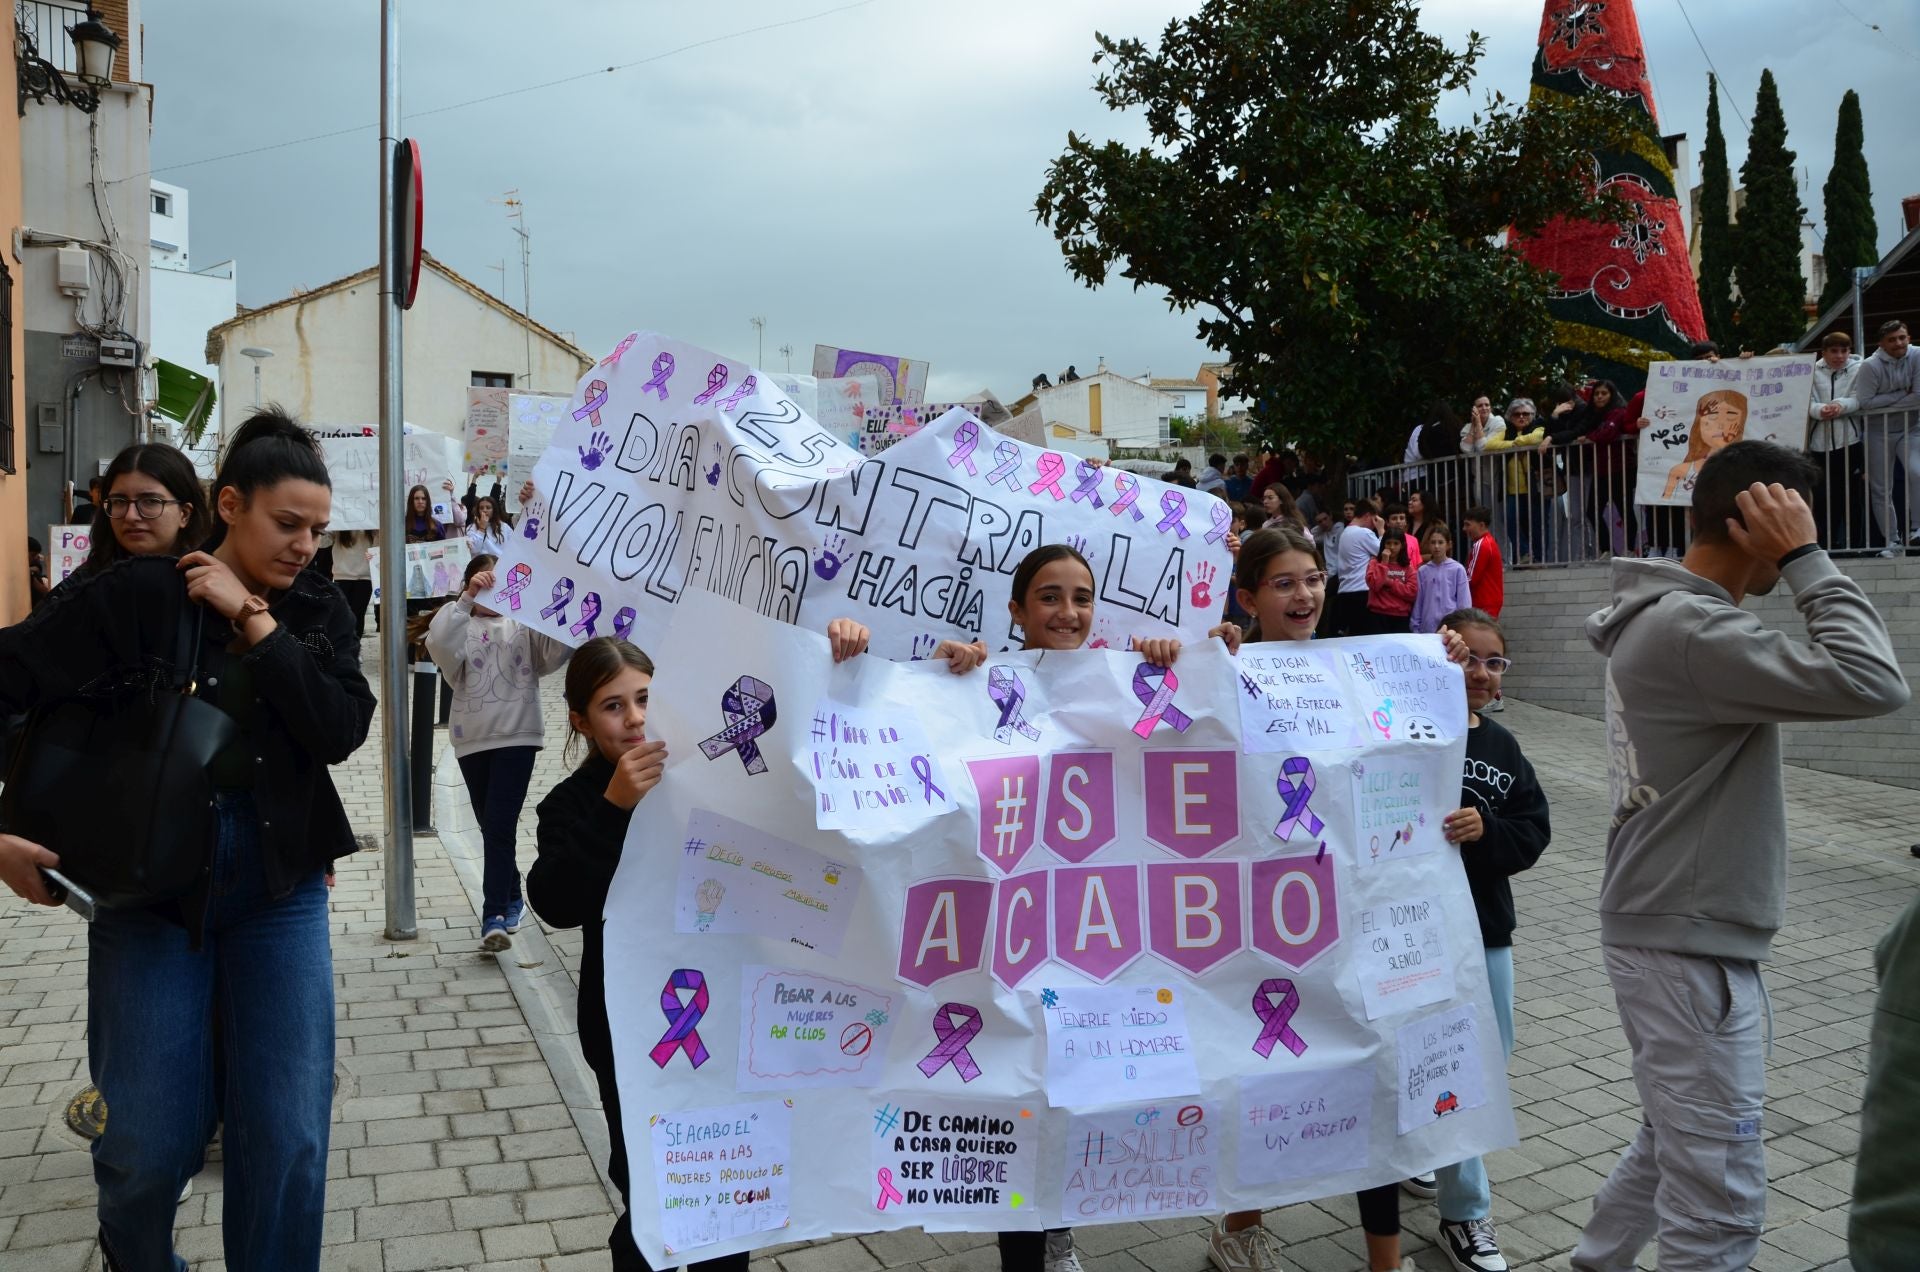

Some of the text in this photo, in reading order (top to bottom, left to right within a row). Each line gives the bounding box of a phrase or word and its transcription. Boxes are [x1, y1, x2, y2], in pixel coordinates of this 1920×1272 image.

[615, 412, 700, 491] DIA
[736, 400, 837, 467] 25
[1100, 533, 1184, 627] LA
[1241, 656, 1310, 670] QUE DIGAN
[1390, 654, 1421, 674] DECIR
[1257, 673, 1325, 687] QUE PONERSE
[1371, 676, 1449, 697] LLORAR ES DE
[1267, 693, 1342, 711] ROPA ESTRECHA
[1306, 715, 1336, 736] MAL
[874, 762, 903, 778] DE
[914, 870, 1321, 968] ACABO
[1361, 911, 1381, 933] EL
[1404, 933, 1416, 947] EL
[774, 983, 857, 1007] PEGAR A LAS
[787, 1010, 834, 1025] MUJERES
[1050, 1006, 1167, 1027] TENERLE MIEDO
[771, 1025, 826, 1041] POR CELOS
[1065, 1035, 1185, 1057] A UN HOMBRE
[939, 1115, 1014, 1135] CAMINO
[894, 1136, 1017, 1154] A CASA QUIERO
[1265, 1131, 1293, 1151] UN
[666, 1145, 753, 1165] REGALAR A LAS
[667, 1172, 711, 1184] MUJERES
[772, 1164, 783, 1177] DE
[901, 1154, 1008, 1184] SER LIBRE
[1124, 1166, 1210, 1189] CALLE
[704, 1195, 711, 1206] Y
[718, 1193, 731, 1204] DE
[907, 1185, 1000, 1204] NO VALIENTE
[1078, 1192, 1136, 1216] CON
